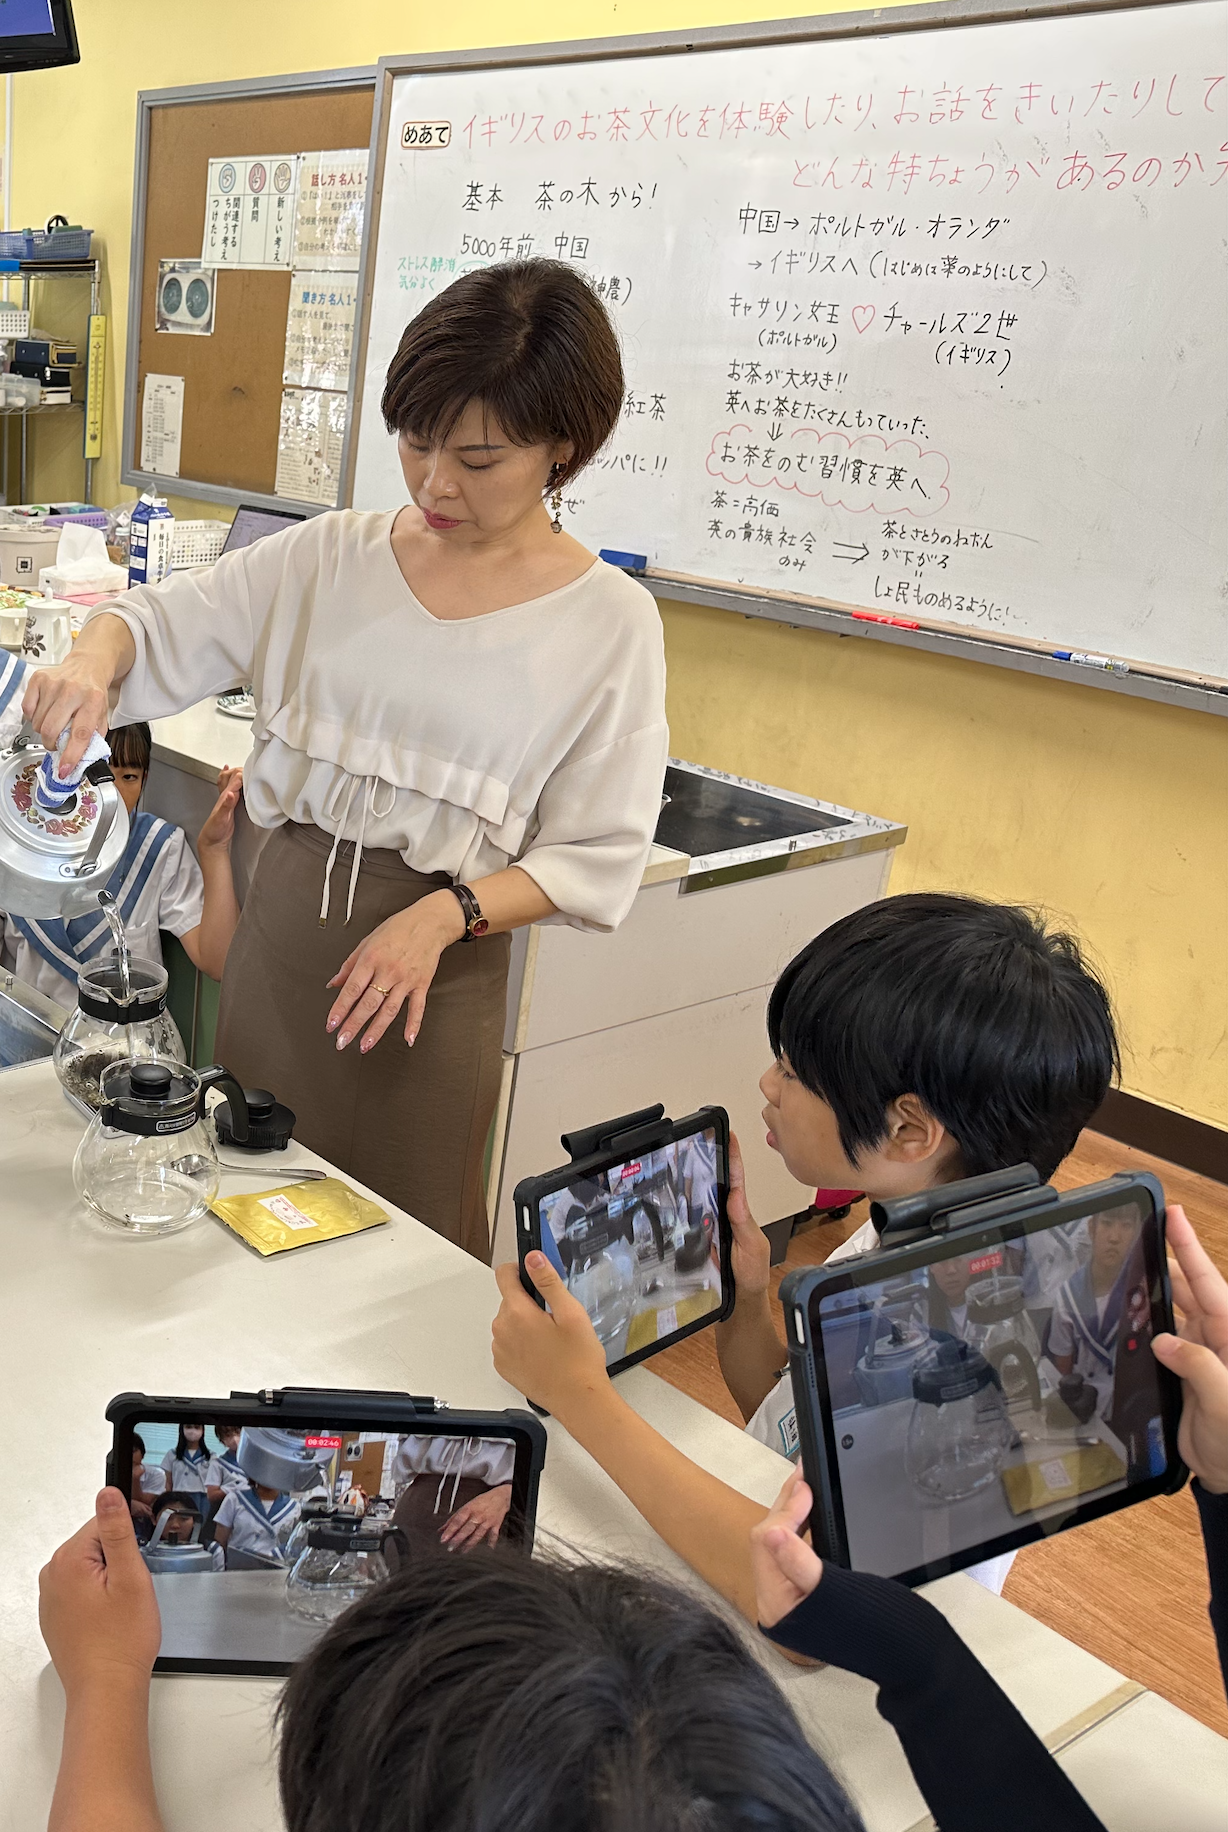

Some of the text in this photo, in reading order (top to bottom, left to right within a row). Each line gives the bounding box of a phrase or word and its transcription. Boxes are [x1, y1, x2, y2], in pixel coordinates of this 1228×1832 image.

[404, 125, 450, 145] めあて
[311, 173, 336, 186] 話し方
[250, 197, 260, 223] 質問
[461, 180, 504, 212] 基本
[210, 199, 220, 247] つけたし
[221, 198, 231, 260] ちがう考え
[231, 197, 241, 248] 関連する
[273, 196, 285, 262] 新しい考え
[738, 201, 781, 235] 中国
[460, 231, 589, 260] 5000年前 中国
[397, 256, 457, 273] ストレス解消
[770, 248, 859, 275] イギリスへ
[399, 274, 435, 290] 気分よく
[302, 291, 327, 305] 聞き方
[728, 292, 840, 325] キャサリン女王
[935, 340, 1012, 376] (イギリス)
[624, 390, 666, 421] 紅茶
[707, 518, 817, 555] 英の貴族社会
[881, 519, 993, 549] 茶とさとうのねだん
[778, 555, 807, 572] のみ
